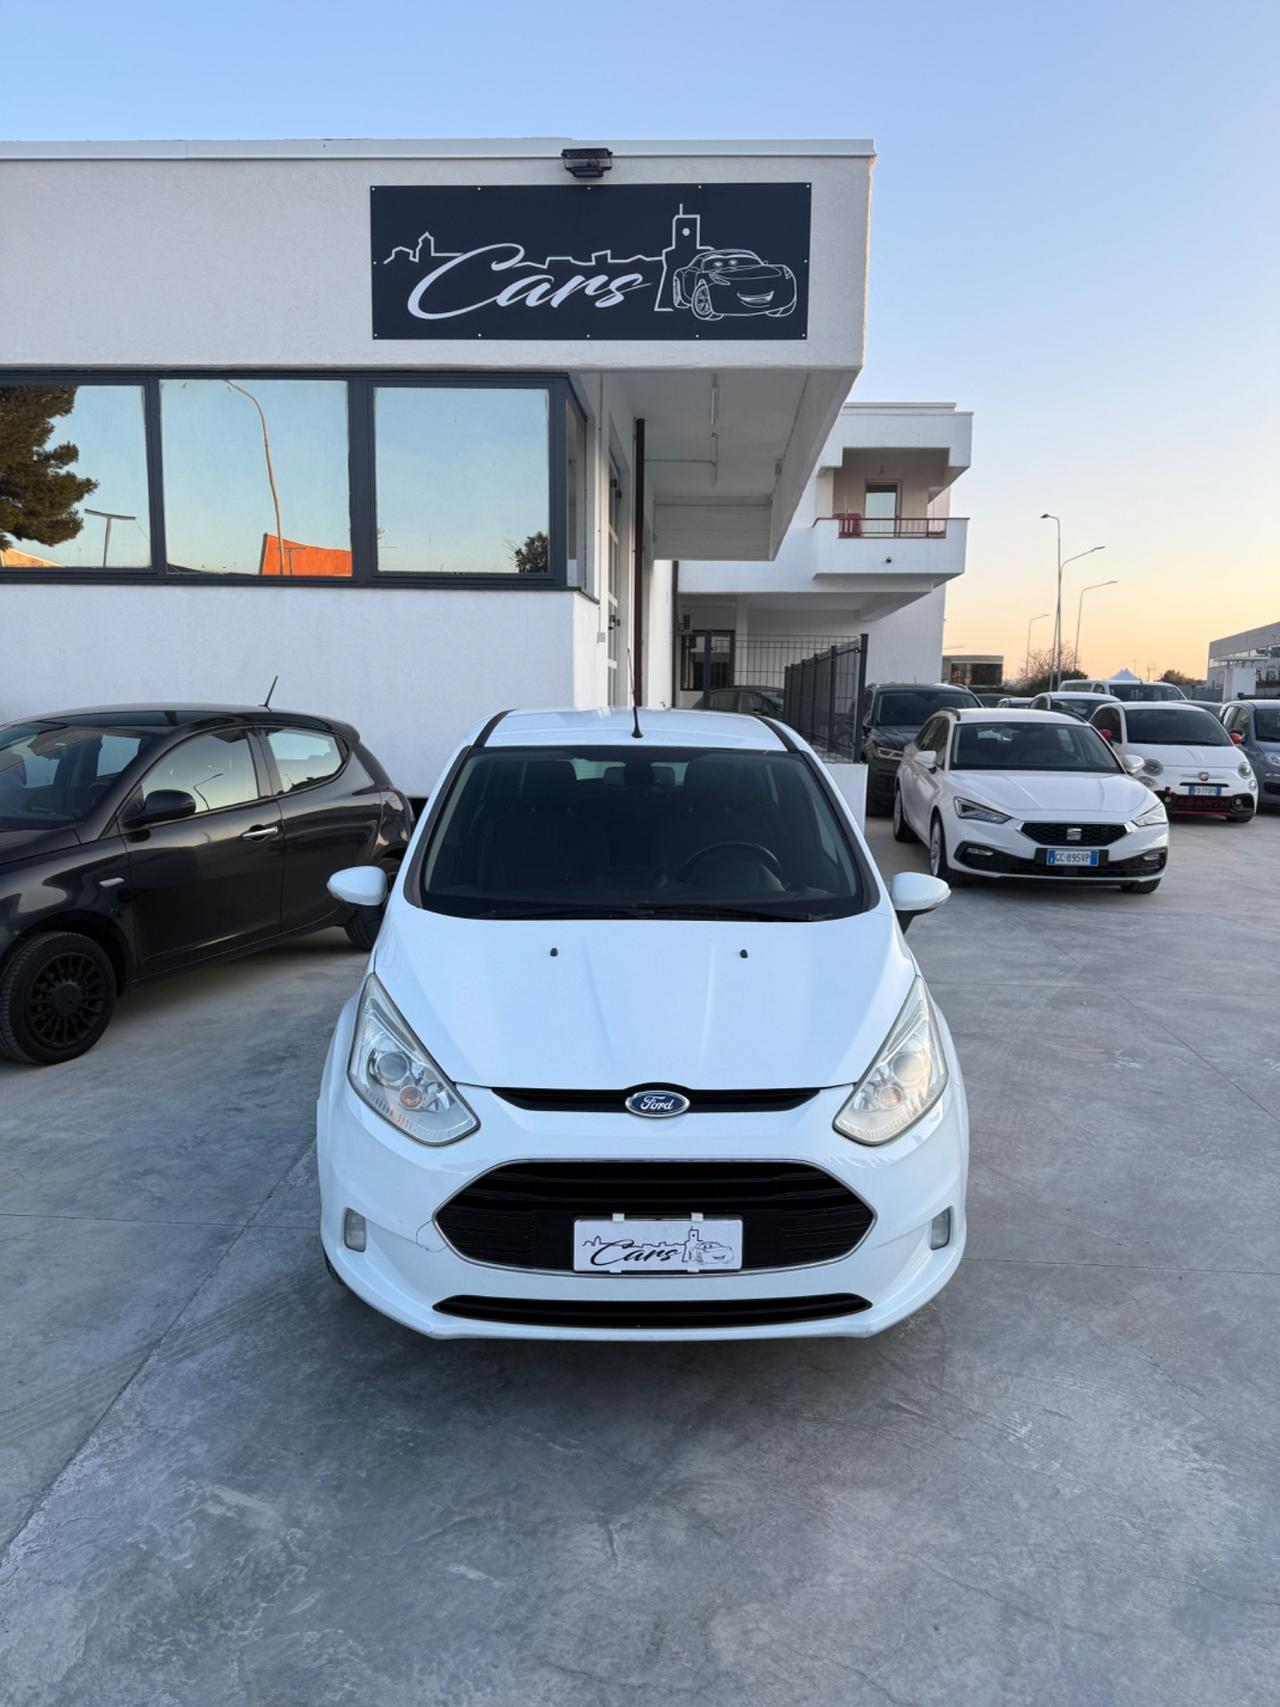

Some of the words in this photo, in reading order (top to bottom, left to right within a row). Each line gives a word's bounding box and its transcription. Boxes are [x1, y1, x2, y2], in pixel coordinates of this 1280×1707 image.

[407, 243, 651, 319] Cars
[640, 1096, 674, 1110] Ford
[590, 1239, 681, 1266] Cars
